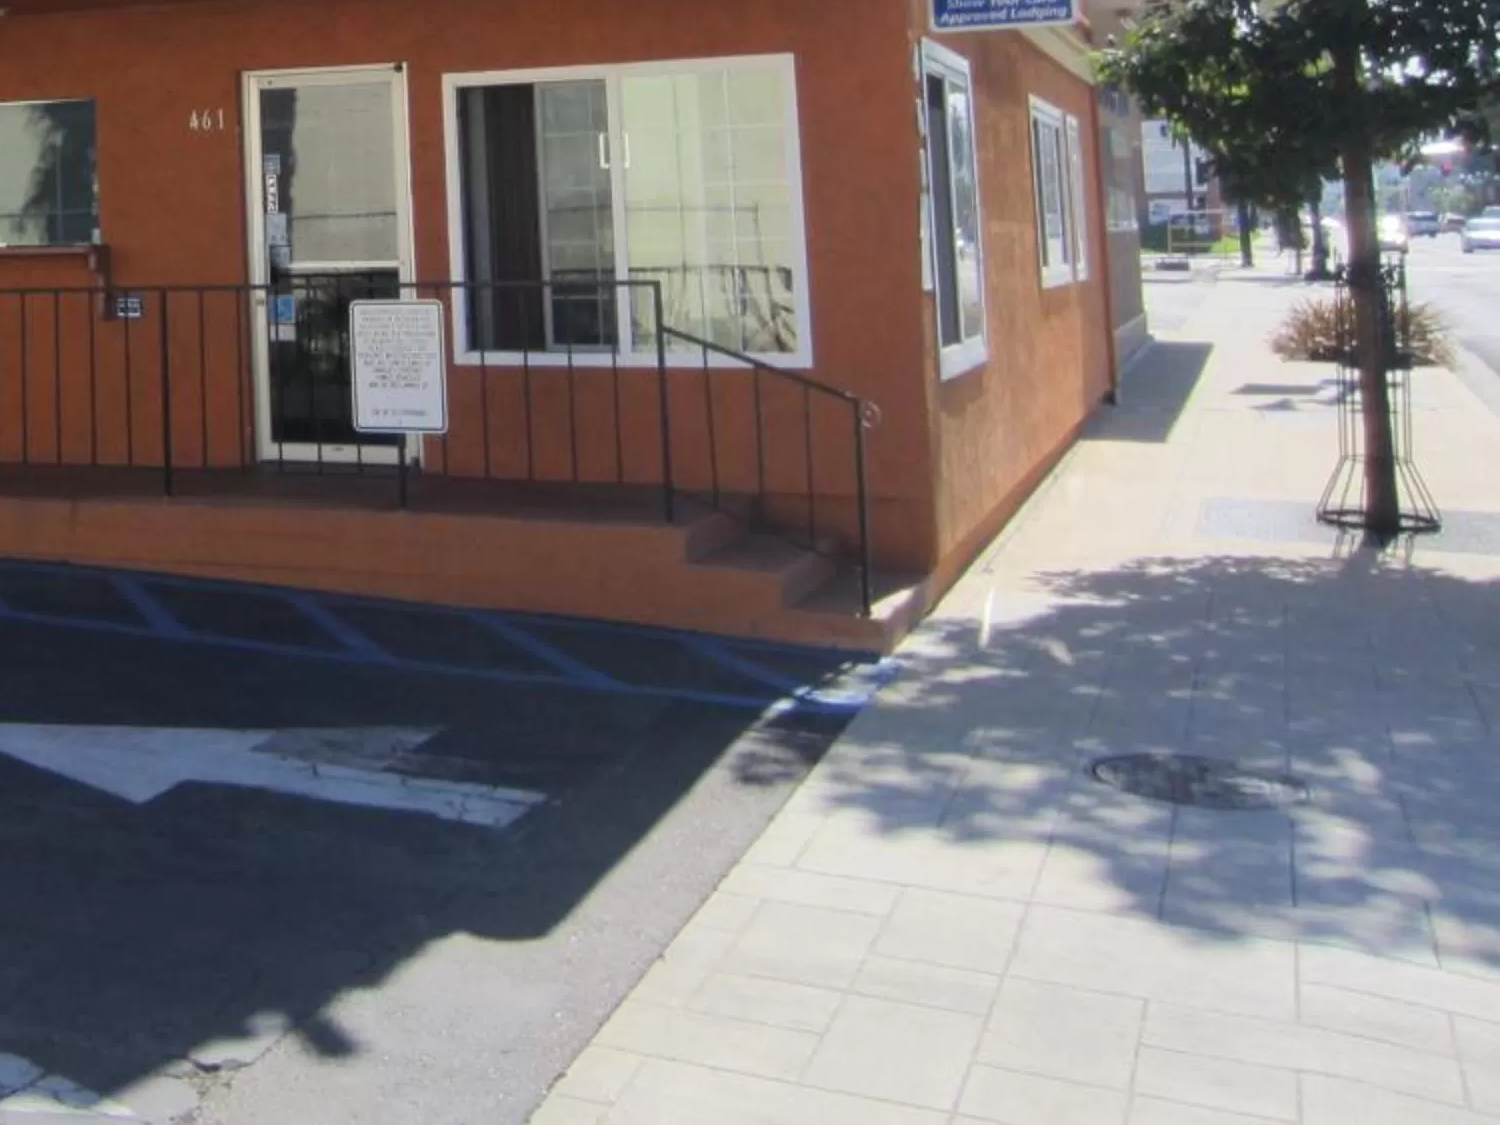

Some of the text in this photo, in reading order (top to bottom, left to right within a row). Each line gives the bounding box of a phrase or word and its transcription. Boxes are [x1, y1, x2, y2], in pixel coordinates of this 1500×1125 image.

[940, 5, 1068, 25] Approved Lodging
[188, 107, 225, 131] 461
